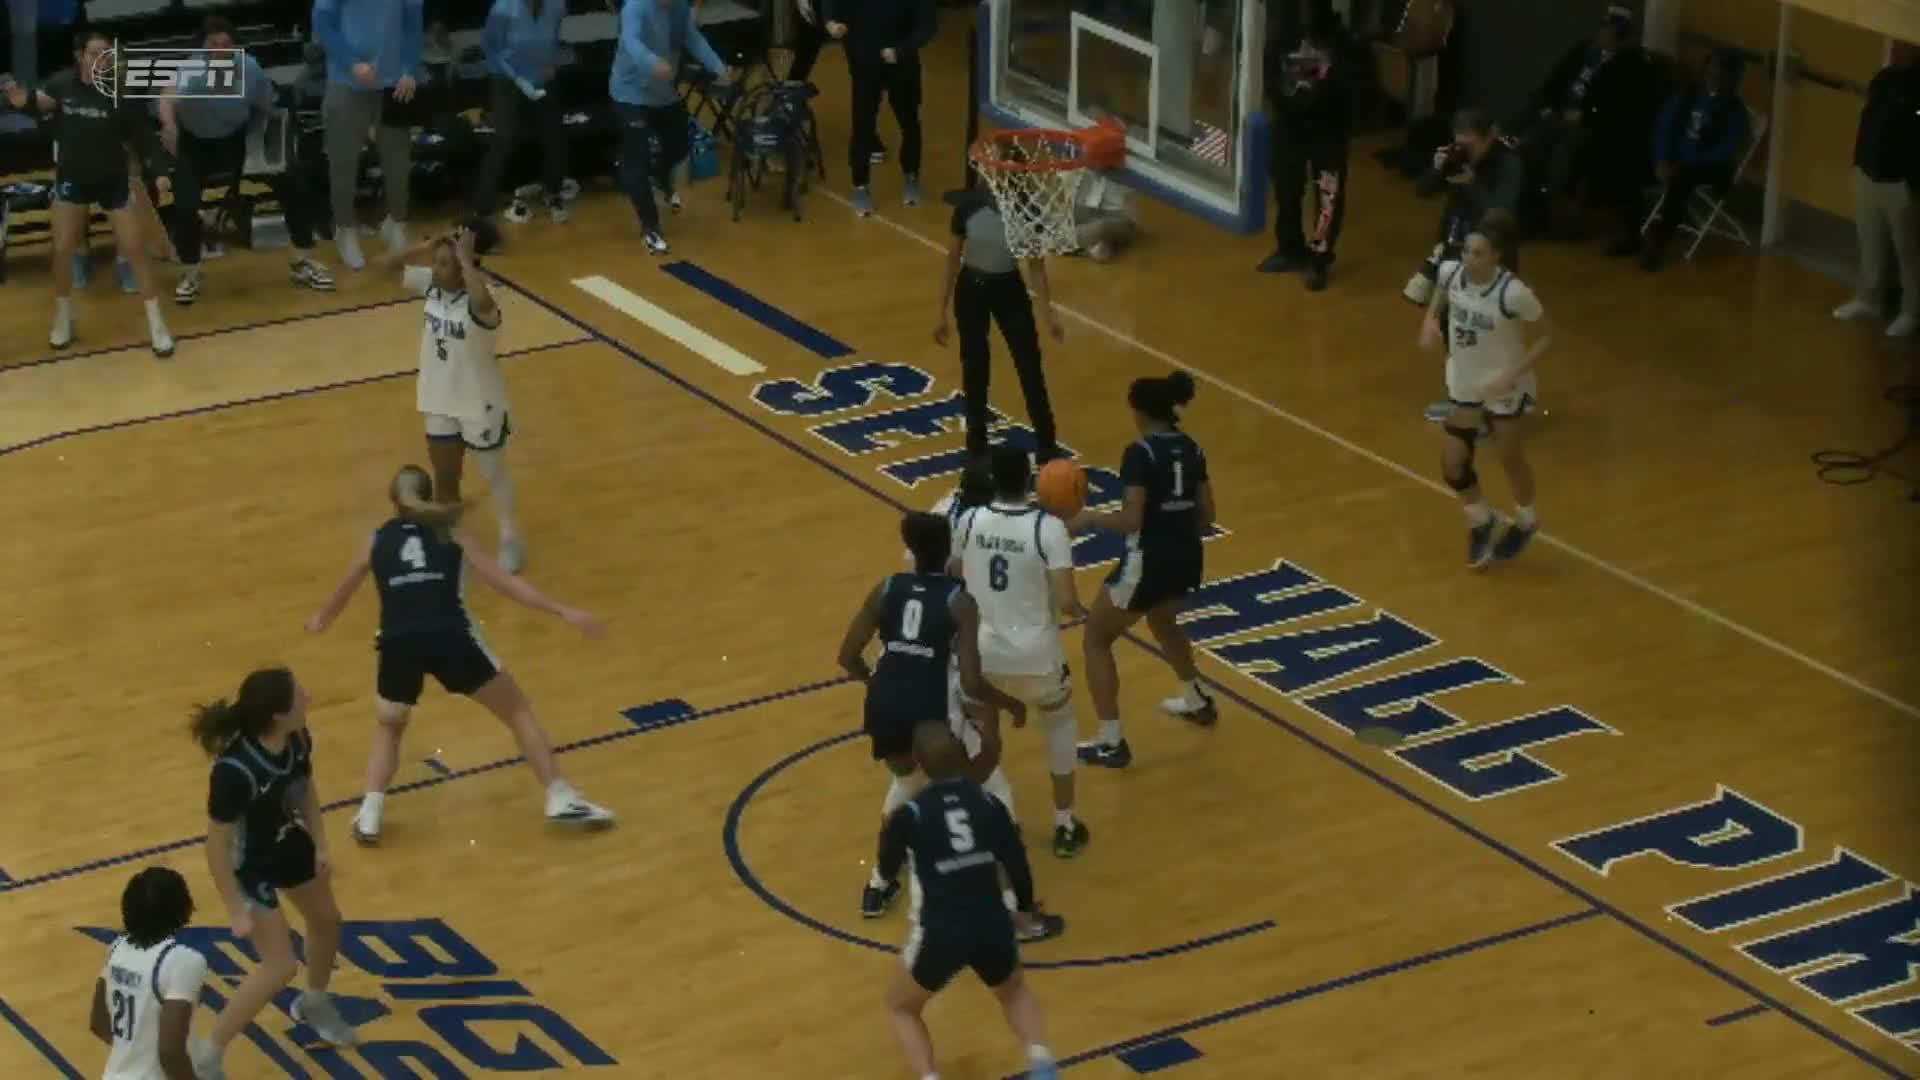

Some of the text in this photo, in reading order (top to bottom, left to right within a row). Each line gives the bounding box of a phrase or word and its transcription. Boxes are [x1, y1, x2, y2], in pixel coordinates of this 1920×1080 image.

[1172, 461, 1184, 497] 1
[401, 536, 426, 569] 4
[989, 553, 1009, 593] 6
[903, 599, 923, 640] 0
[1177, 557, 1623, 802] HALL
[944, 807, 975, 853] 5
[112, 988, 135, 1041] 21
[338, 917, 620, 1072] BIG
